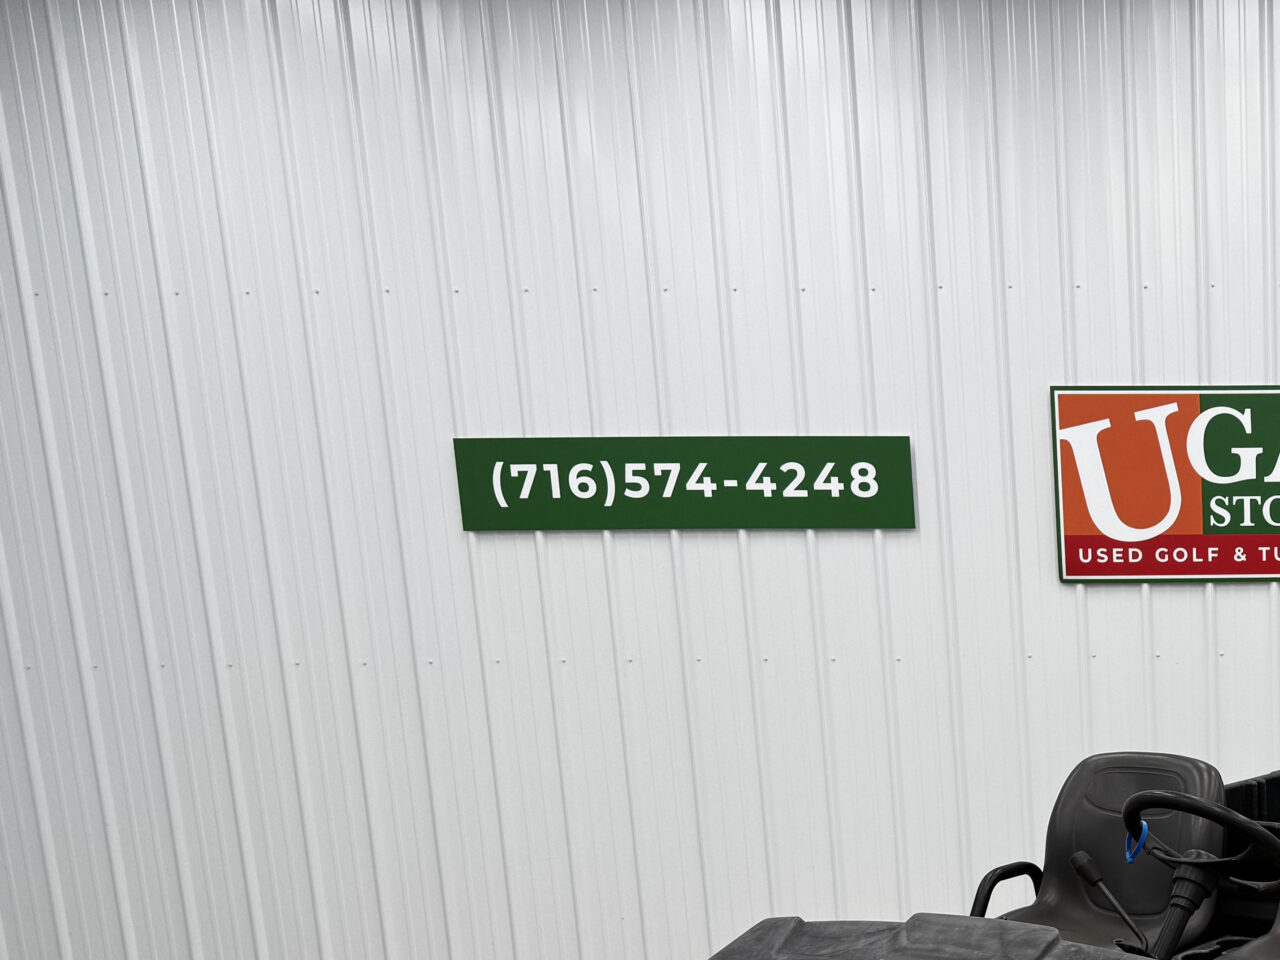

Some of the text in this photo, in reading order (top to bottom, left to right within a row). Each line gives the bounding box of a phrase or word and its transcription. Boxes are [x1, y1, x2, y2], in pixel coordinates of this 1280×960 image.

[492, 460, 879, 508] (716)574-4248
[1078, 547, 1144, 564] USED
[1154, 547, 1220, 563] GOLF
[1233, 546, 1248, 562] &
